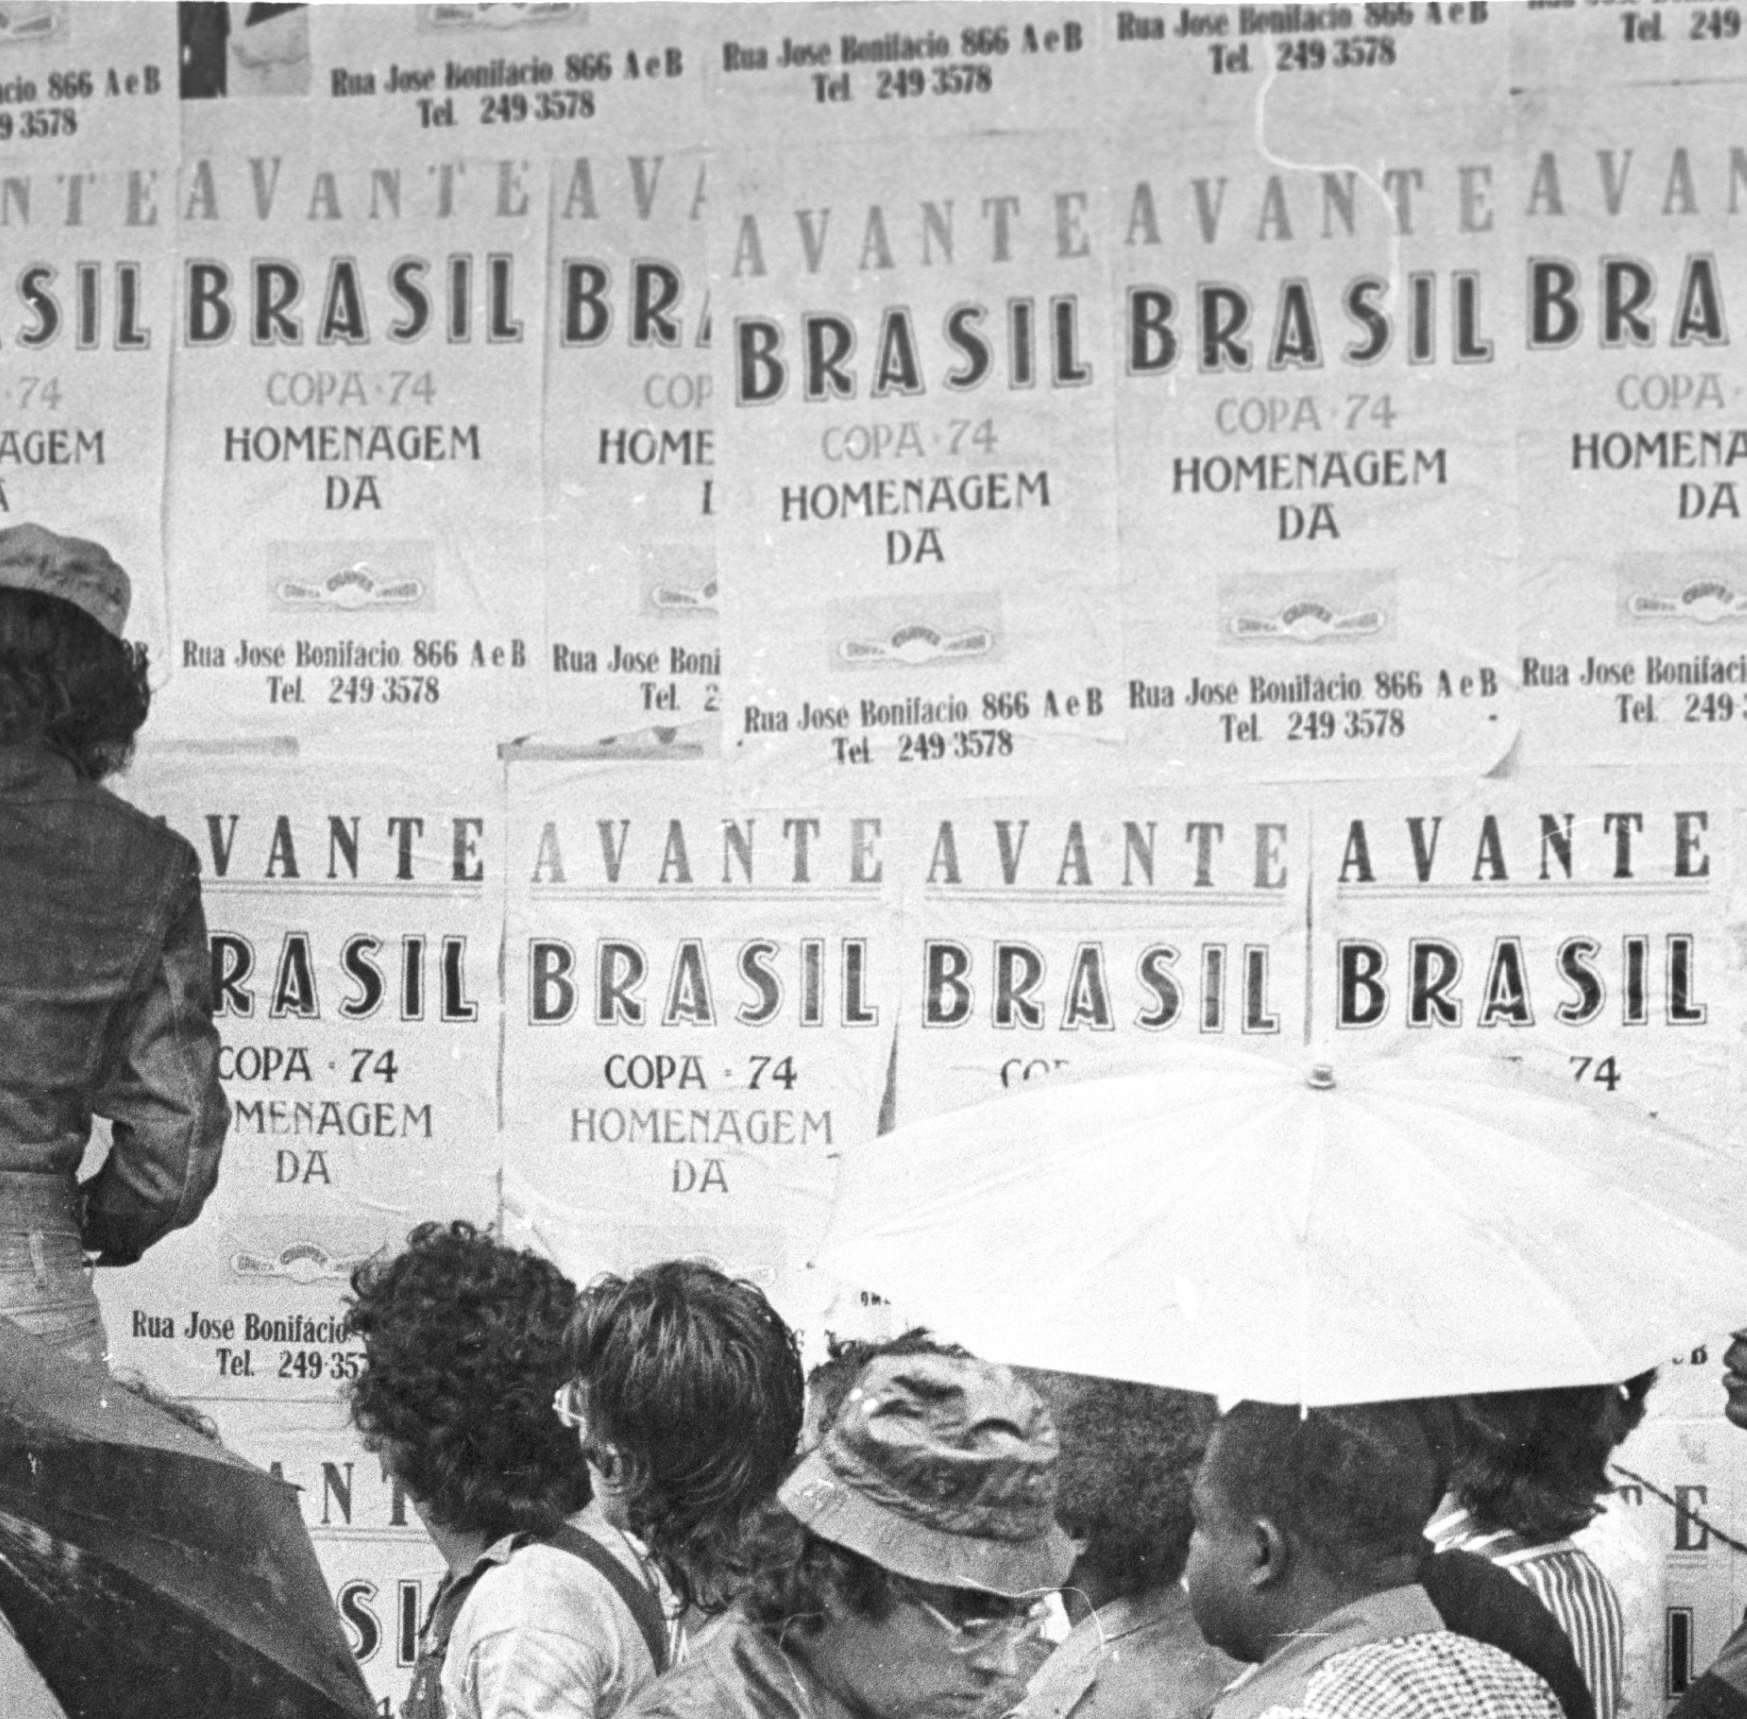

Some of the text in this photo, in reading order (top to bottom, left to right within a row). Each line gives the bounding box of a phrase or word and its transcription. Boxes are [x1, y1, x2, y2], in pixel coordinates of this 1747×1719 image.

[1123, 165, 1497, 248] AVANTE
[731, 191, 1093, 279] AVANTE
[184, 251, 523, 347] BRASIL
[1125, 269, 1494, 377] BRASIL
[733, 292, 1092, 407] BRASIL
[224, 424, 481, 462] HOMENAGEM
[325, 474, 382, 511] DA
[781, 469, 1051, 522] HOMENAGEM
[1172, 447, 1447, 493] HOMENAGEM
[1278, 502, 1340, 541] DA
[1678, 481, 1740, 520] DA
[886, 526, 945, 566] DA
[182, 638, 225, 668] Rua
[413, 639, 459, 667] 866
[511, 638, 527, 668] B
[204, 814, 487, 885] VANTE
[529, 818, 885, 887] AVANTE
[925, 818, 1289, 893] AVANTE
[1336, 811, 1711, 886] AVANTE
[209, 934, 479, 1025] RASIL
[526, 936, 878, 1028] BRASIL
[921, 937, 1281, 1036] BRASIL
[1336, 932, 1707, 1029] BRASIL
[603, 1054, 707, 1090] COPA
[231, 1099, 435, 1141] MENAGEM
[569, 1106, 833, 1146] HOMENAGEM
[275, 1148, 332, 1185] DA
[672, 1158, 729, 1194] DA
[132, 1309, 175, 1339] Rua
